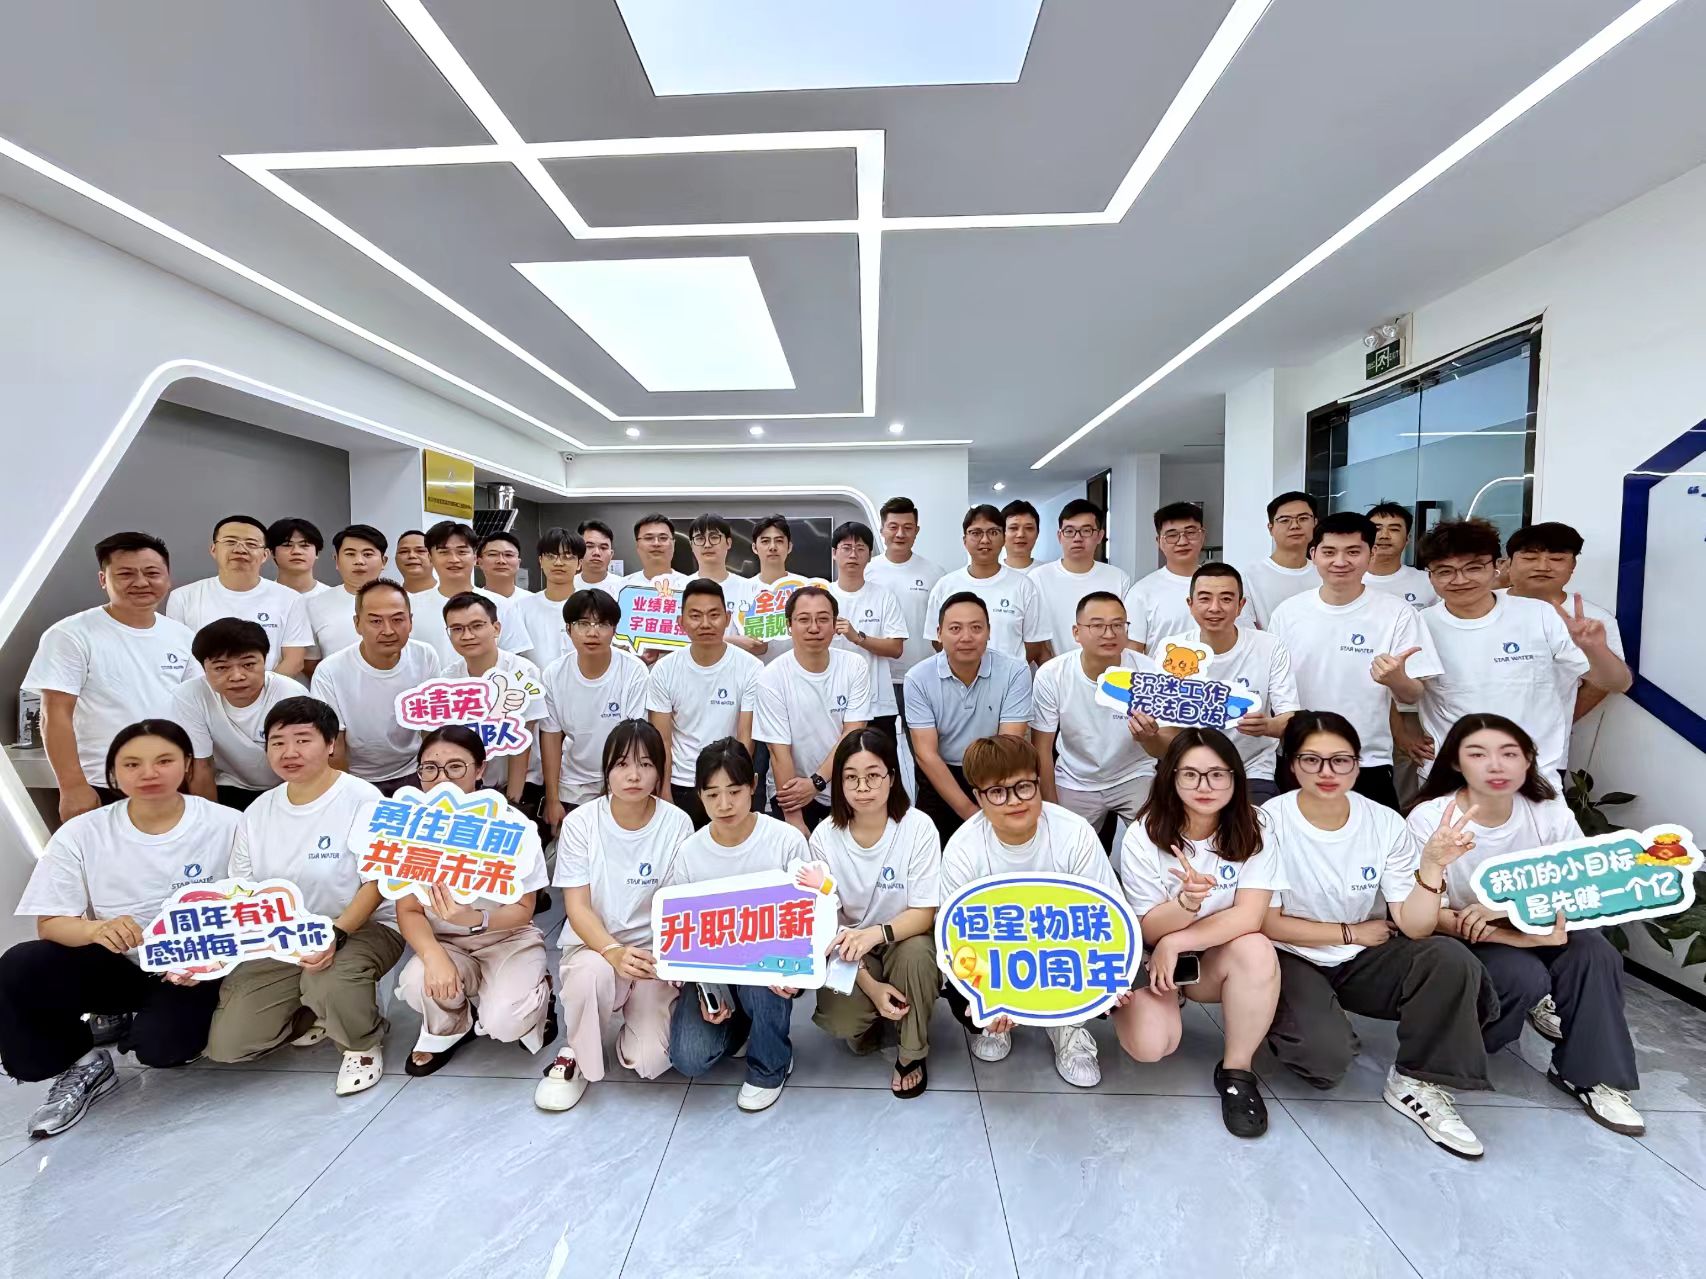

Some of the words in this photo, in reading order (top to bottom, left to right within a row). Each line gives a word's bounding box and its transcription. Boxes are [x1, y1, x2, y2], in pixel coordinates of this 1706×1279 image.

[632, 596, 683, 614] 业绩第
[409, 688, 484, 720] 精英
[1132, 673, 1229, 704] 沉迷工作
[1130, 695, 1224, 726] 无法自拔
[368, 800, 526, 857] 勇往直前
[171, 880, 190, 890] STAR
[360, 839, 516, 896] 共赢未来
[1489, 847, 1636, 895] 我们的小目标
[169, 897, 294, 934] 周年有礼
[1525, 871, 1679, 919] 是先赚一个亿
[660, 899, 814, 952] 升职加薪
[952, 904, 1112, 942] 恒星物联
[145, 921, 328, 967] 感谢每一个你
[988, 949, 1130, 993] 10周年
